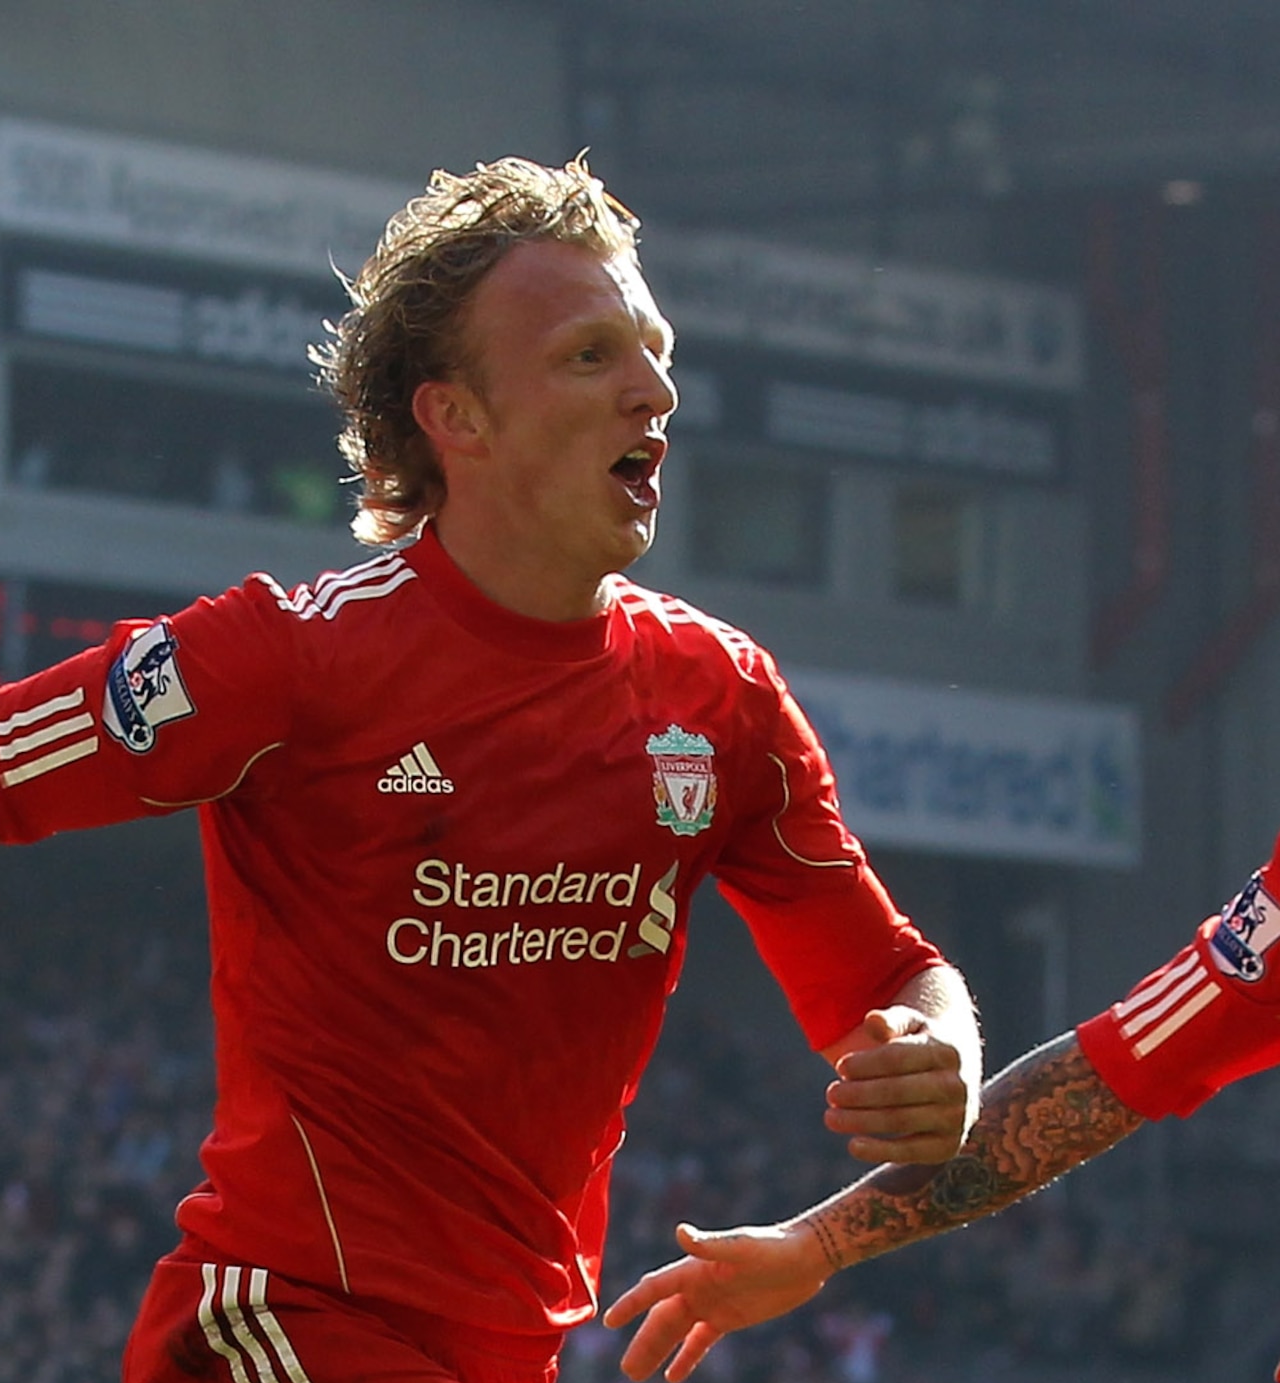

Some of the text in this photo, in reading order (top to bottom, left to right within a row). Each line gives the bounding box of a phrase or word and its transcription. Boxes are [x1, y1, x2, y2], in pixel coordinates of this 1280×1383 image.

[661, 761, 708, 773] LIVERPOOL
[377, 775, 454, 793] adidas
[412, 859, 641, 908] Standard
[386, 918, 627, 968] Chartered
